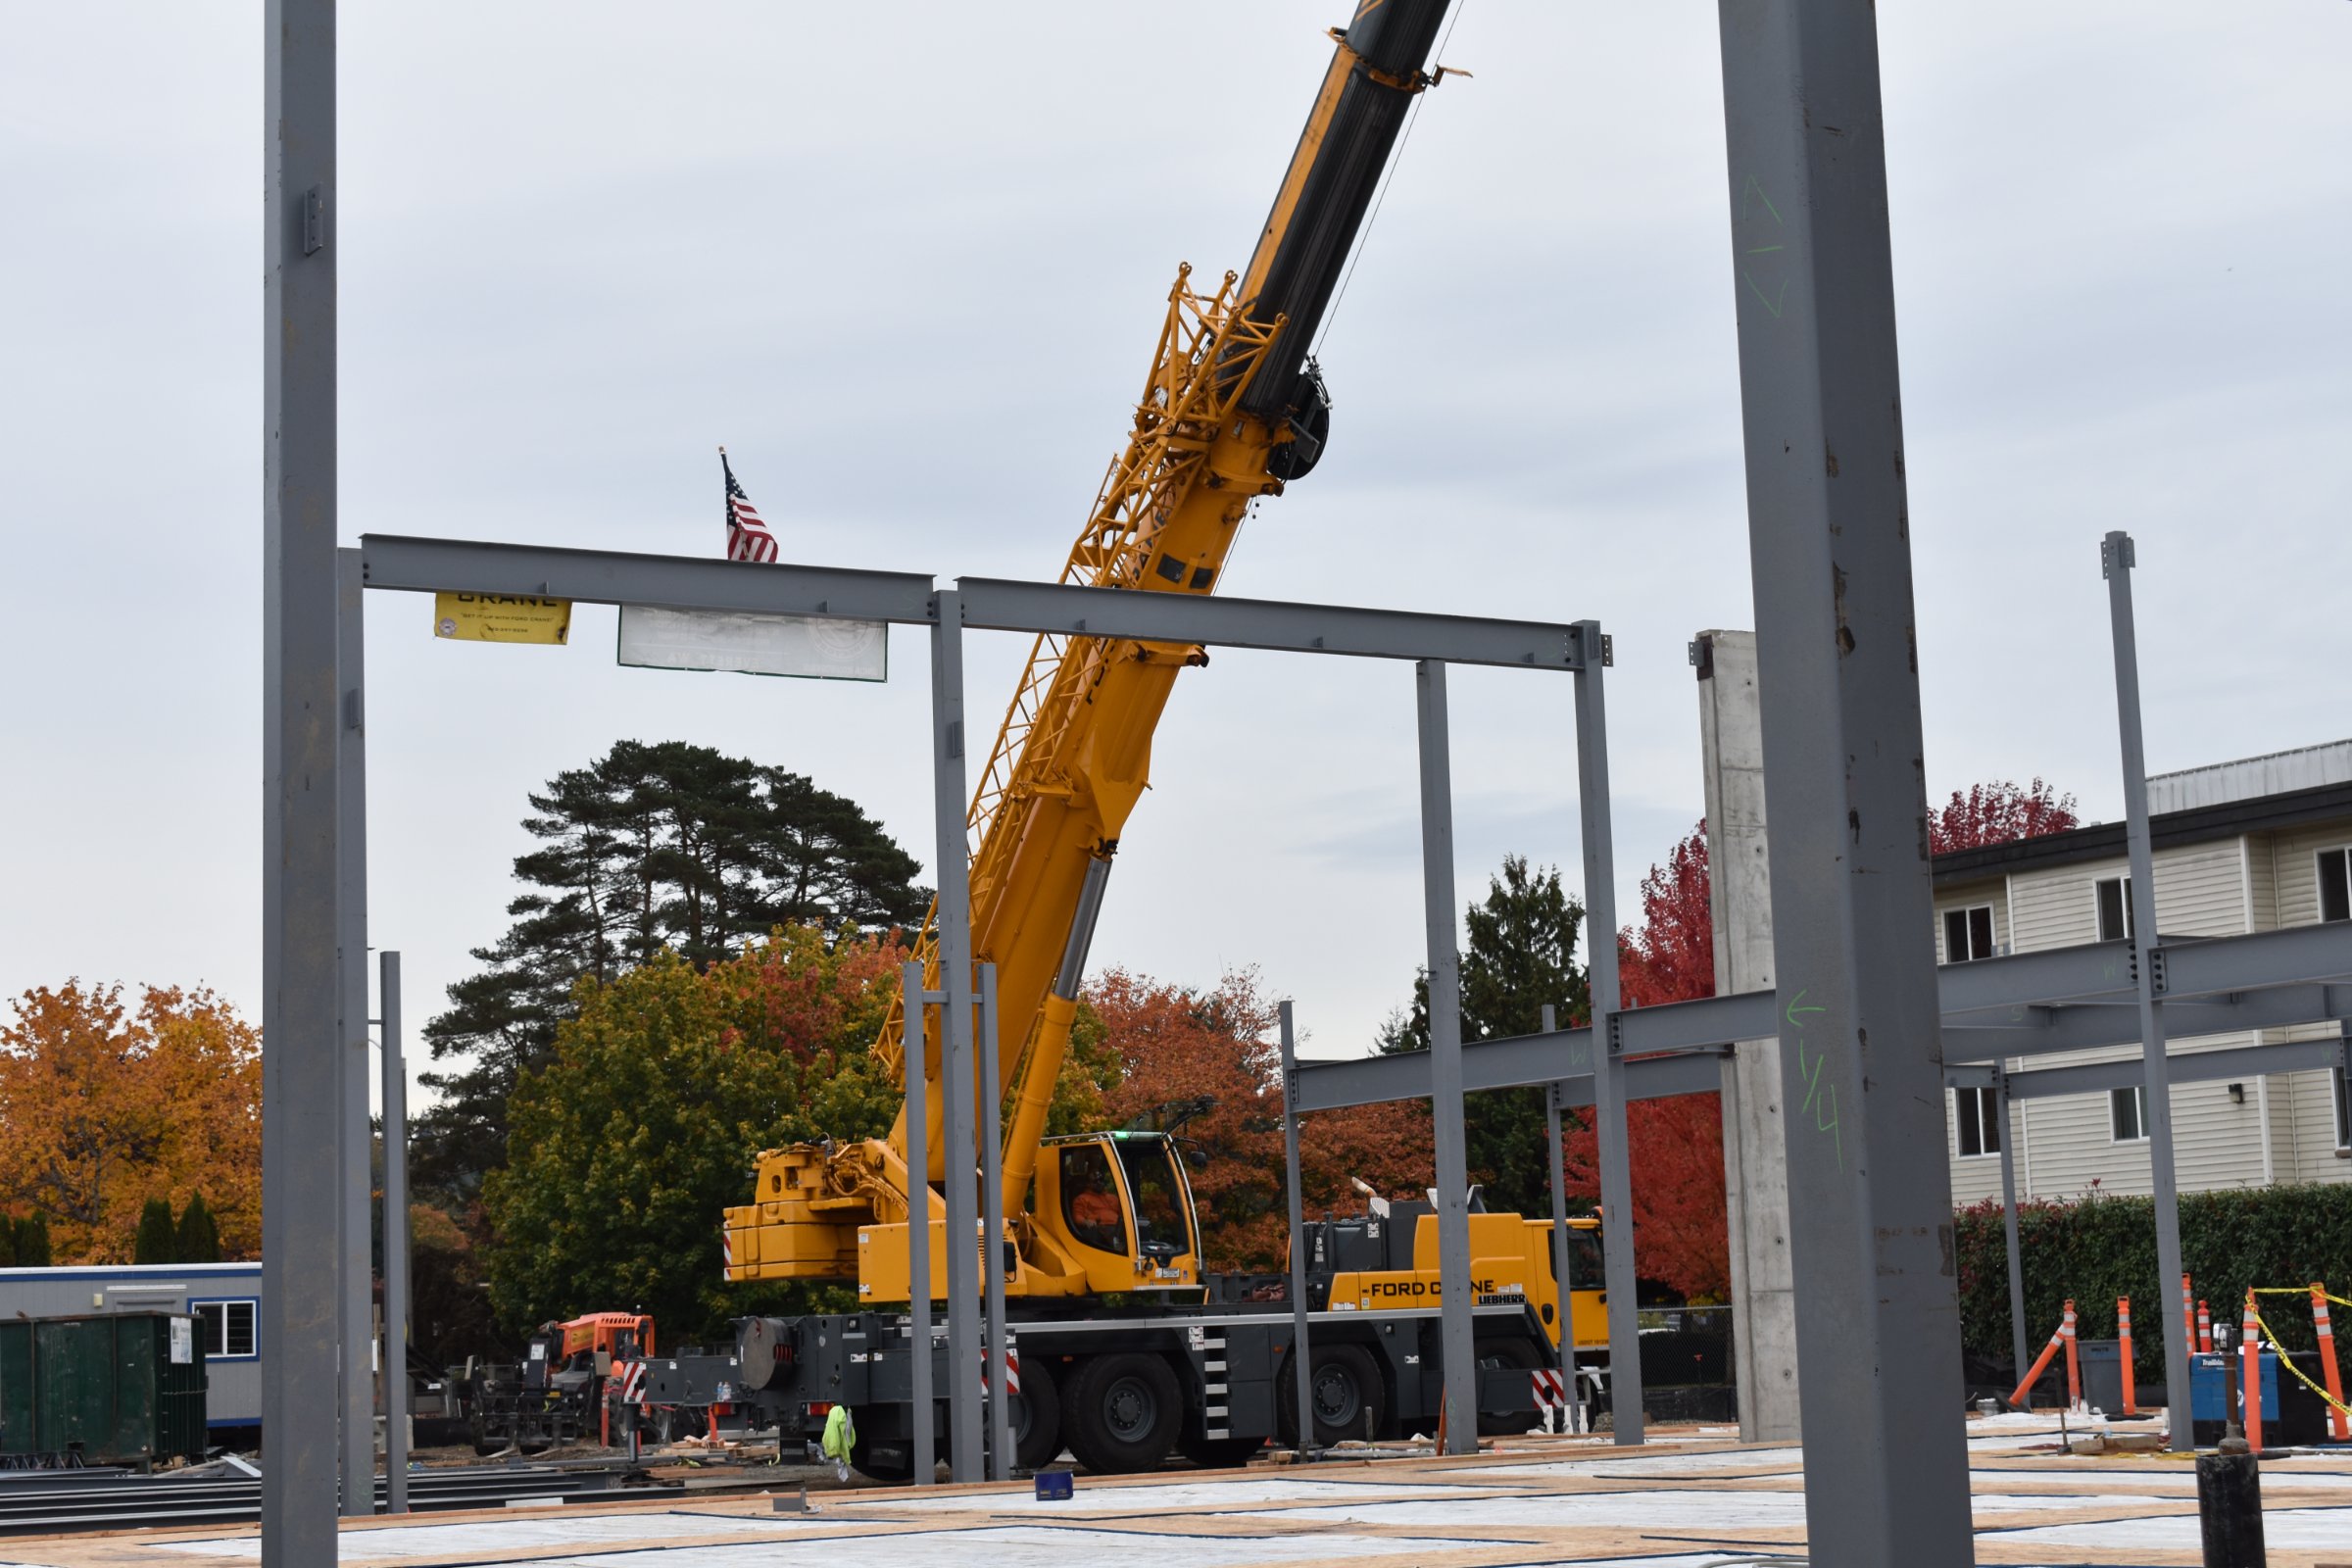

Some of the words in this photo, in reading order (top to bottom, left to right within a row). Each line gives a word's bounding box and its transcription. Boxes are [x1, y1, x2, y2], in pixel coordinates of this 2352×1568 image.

[1372, 1282, 1425, 1297] FORD
[1430, 1280, 1494, 1296] CNE
[1478, 1293, 1526, 1305] LIEBHERR
